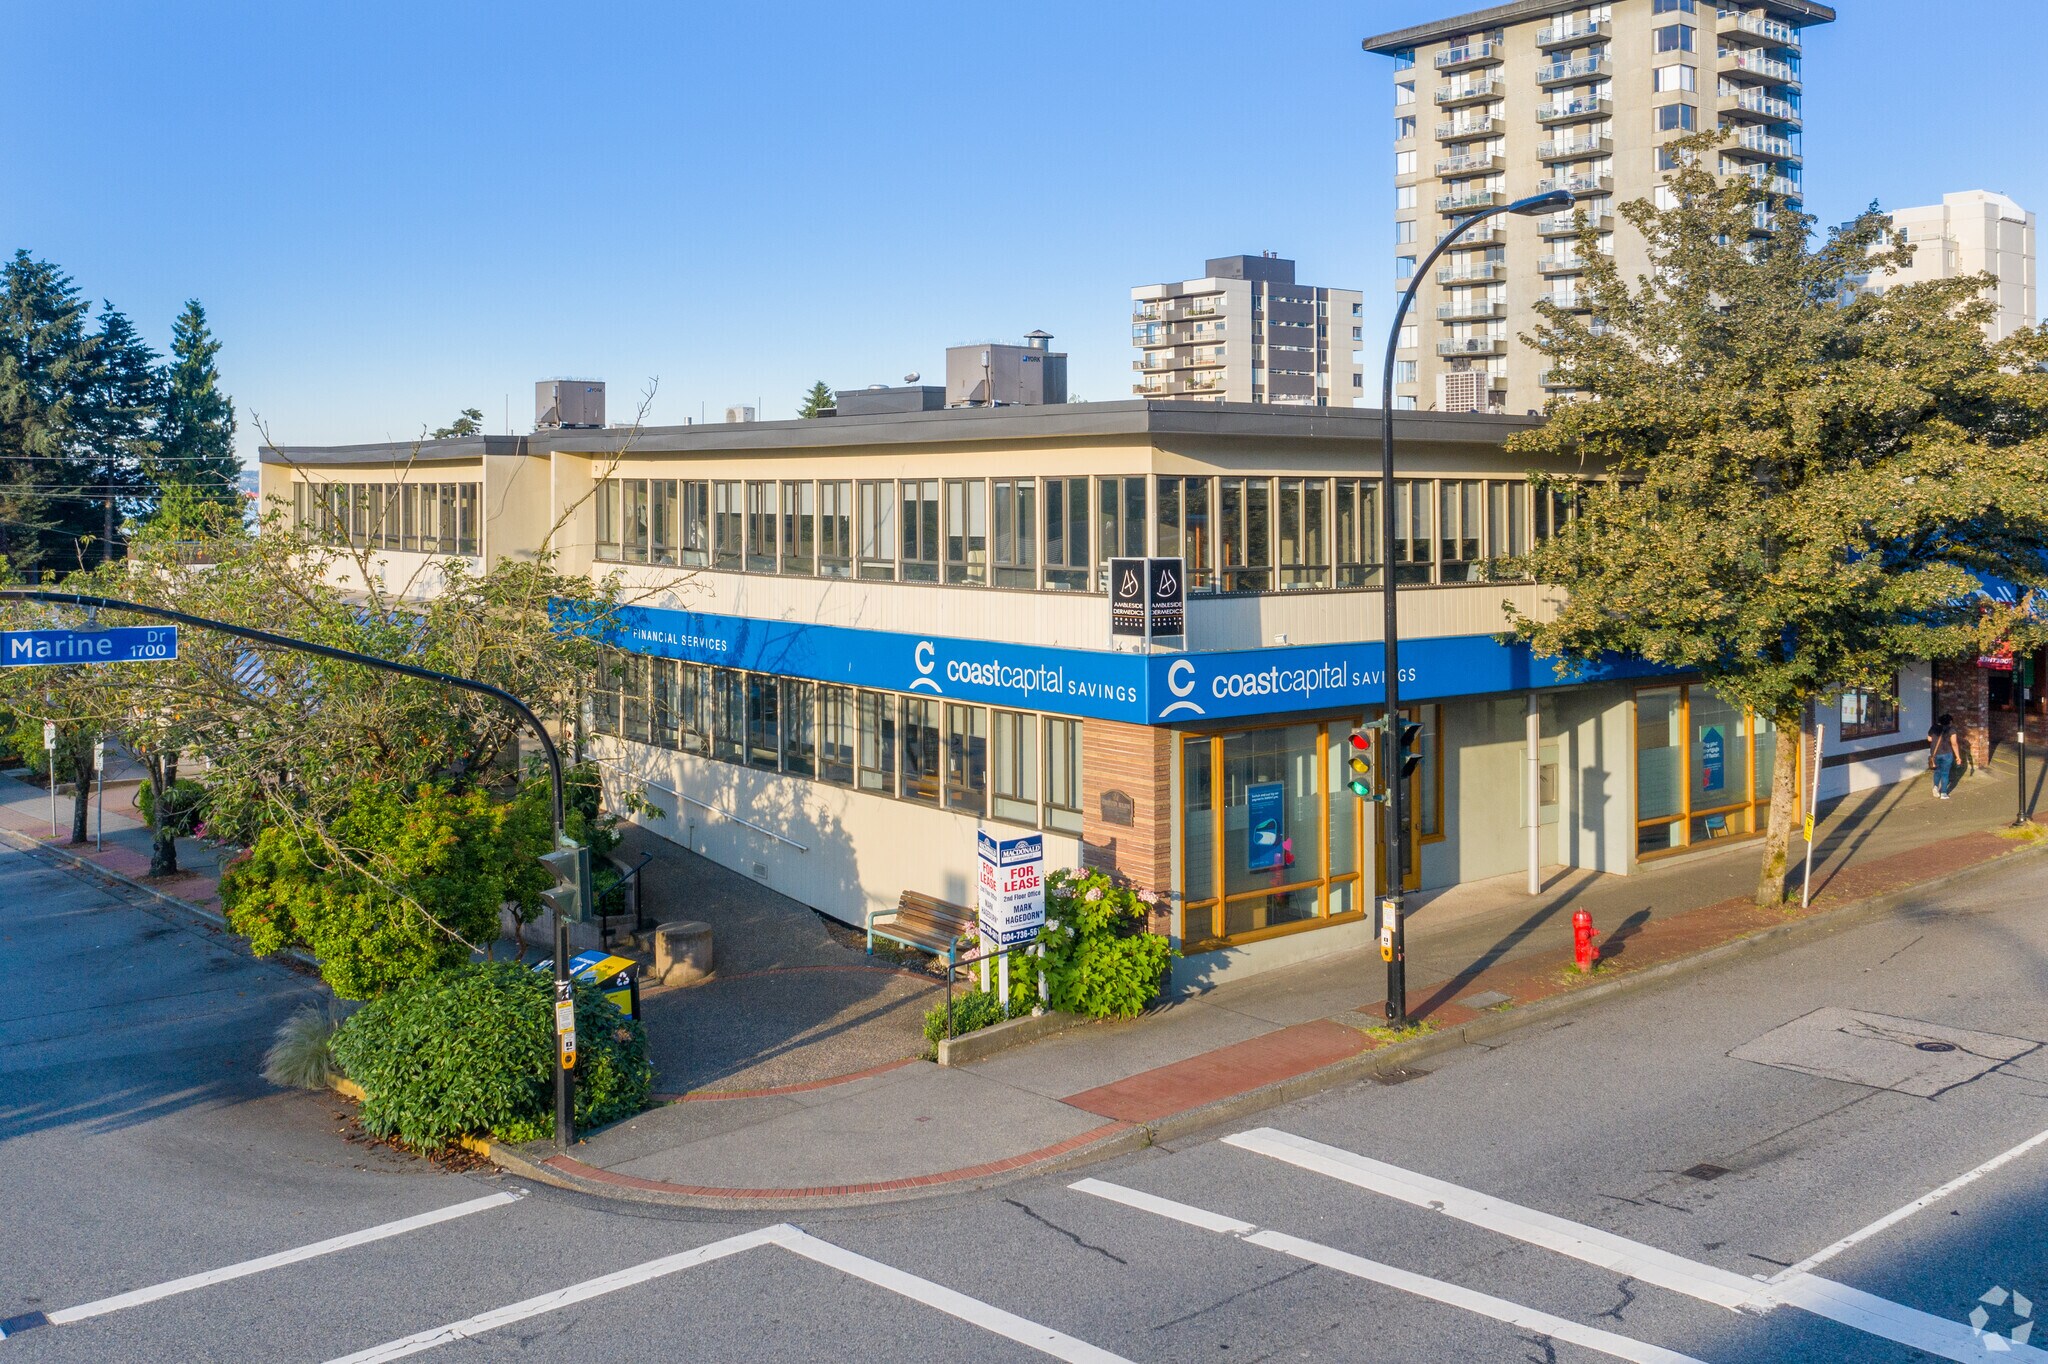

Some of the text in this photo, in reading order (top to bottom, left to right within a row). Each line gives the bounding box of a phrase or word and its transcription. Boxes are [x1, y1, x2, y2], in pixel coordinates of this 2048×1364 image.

[1113, 608, 1144, 616] DERMEDICS
[11, 630, 166, 659] Marine Dr
[633, 628, 727, 652] FINANCIAL SERVICES
[130, 644, 167, 657] 1700
[946, 659, 1063, 698] coastcapital
[1068, 680, 1137, 702] SAVINGS
[1212, 661, 1347, 699] coastcapital
[1352, 667, 1416, 687] SAVIGS
[1003, 845, 1041, 857] MACDONALD
[982, 861, 994, 877] FOR
[1010, 865, 1034, 880] FOR
[980, 872, 997, 892] LEASE
[1004, 876, 1040, 893] LEASE
[1027, 890, 1041, 898] Office
[1013, 902, 1033, 914] MARK
